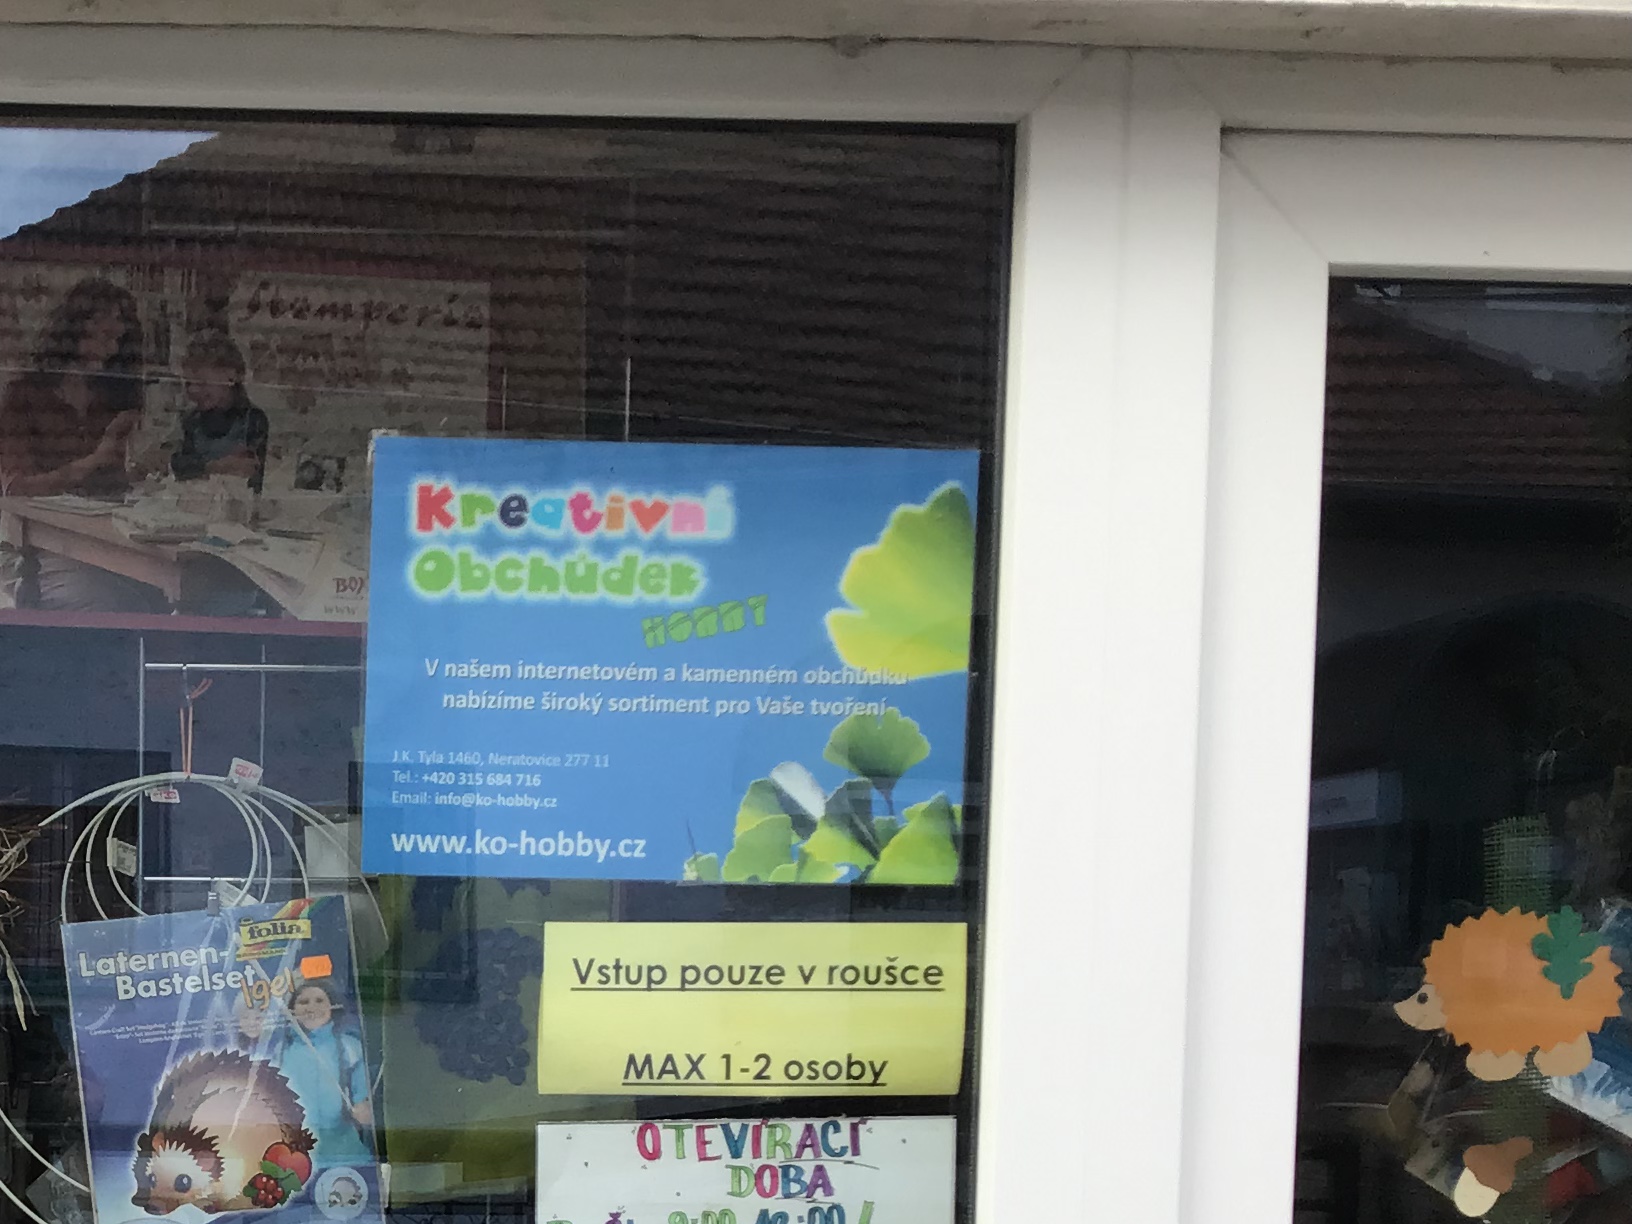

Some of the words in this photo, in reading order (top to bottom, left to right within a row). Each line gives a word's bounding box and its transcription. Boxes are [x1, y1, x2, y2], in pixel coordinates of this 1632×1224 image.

[416, 483, 734, 536] Kreativní
[413, 549, 703, 598] Obchůdek
[424, 658, 440, 678] V
[445, 659, 511, 680] našem
[518, 661, 658, 683] internetovém
[663, 668, 676, 682] a
[682, 664, 798, 685] kamenném
[443, 691, 534, 711] nabízíme
[541, 691, 602, 716] široký
[608, 693, 709, 714] sortiment
[715, 698, 750, 718] pro
[755, 696, 805, 716] Vaše
[811, 696, 886, 716] tvoření
[417, 752, 444, 768] Tyla
[448, 752, 484, 769] 1460,
[565, 754, 589, 767] 277
[593, 755, 609, 767] 11
[392, 771, 418, 785] Tel.:
[422, 772, 455, 786] +420
[459, 773, 483, 786] 315
[486, 773, 511, 786] 684
[516, 773, 541, 787] 716
[392, 790, 432, 806] Email:
[435, 791, 557, 810] info@ko-hobby.cz
[391, 827, 647, 863] www.ko-hobby.cz
[245, 921, 304, 941] folia
[79, 944, 230, 978] Laternen-
[572, 958, 667, 991] Vstup
[681, 963, 785, 991] pouze
[799, 965, 816, 986] v
[828, 956, 943, 986] roušce
[117, 966, 256, 1001] Bastelset
[241, 966, 295, 1010] Igel
[624, 1054, 706, 1081] MAX
[720, 1054, 772, 1081] 1-2
[784, 1054, 888, 1086] osoby
[636, 1118, 871, 1162] OTEVÍRACÍ
[727, 1165, 835, 1199] DOBA
